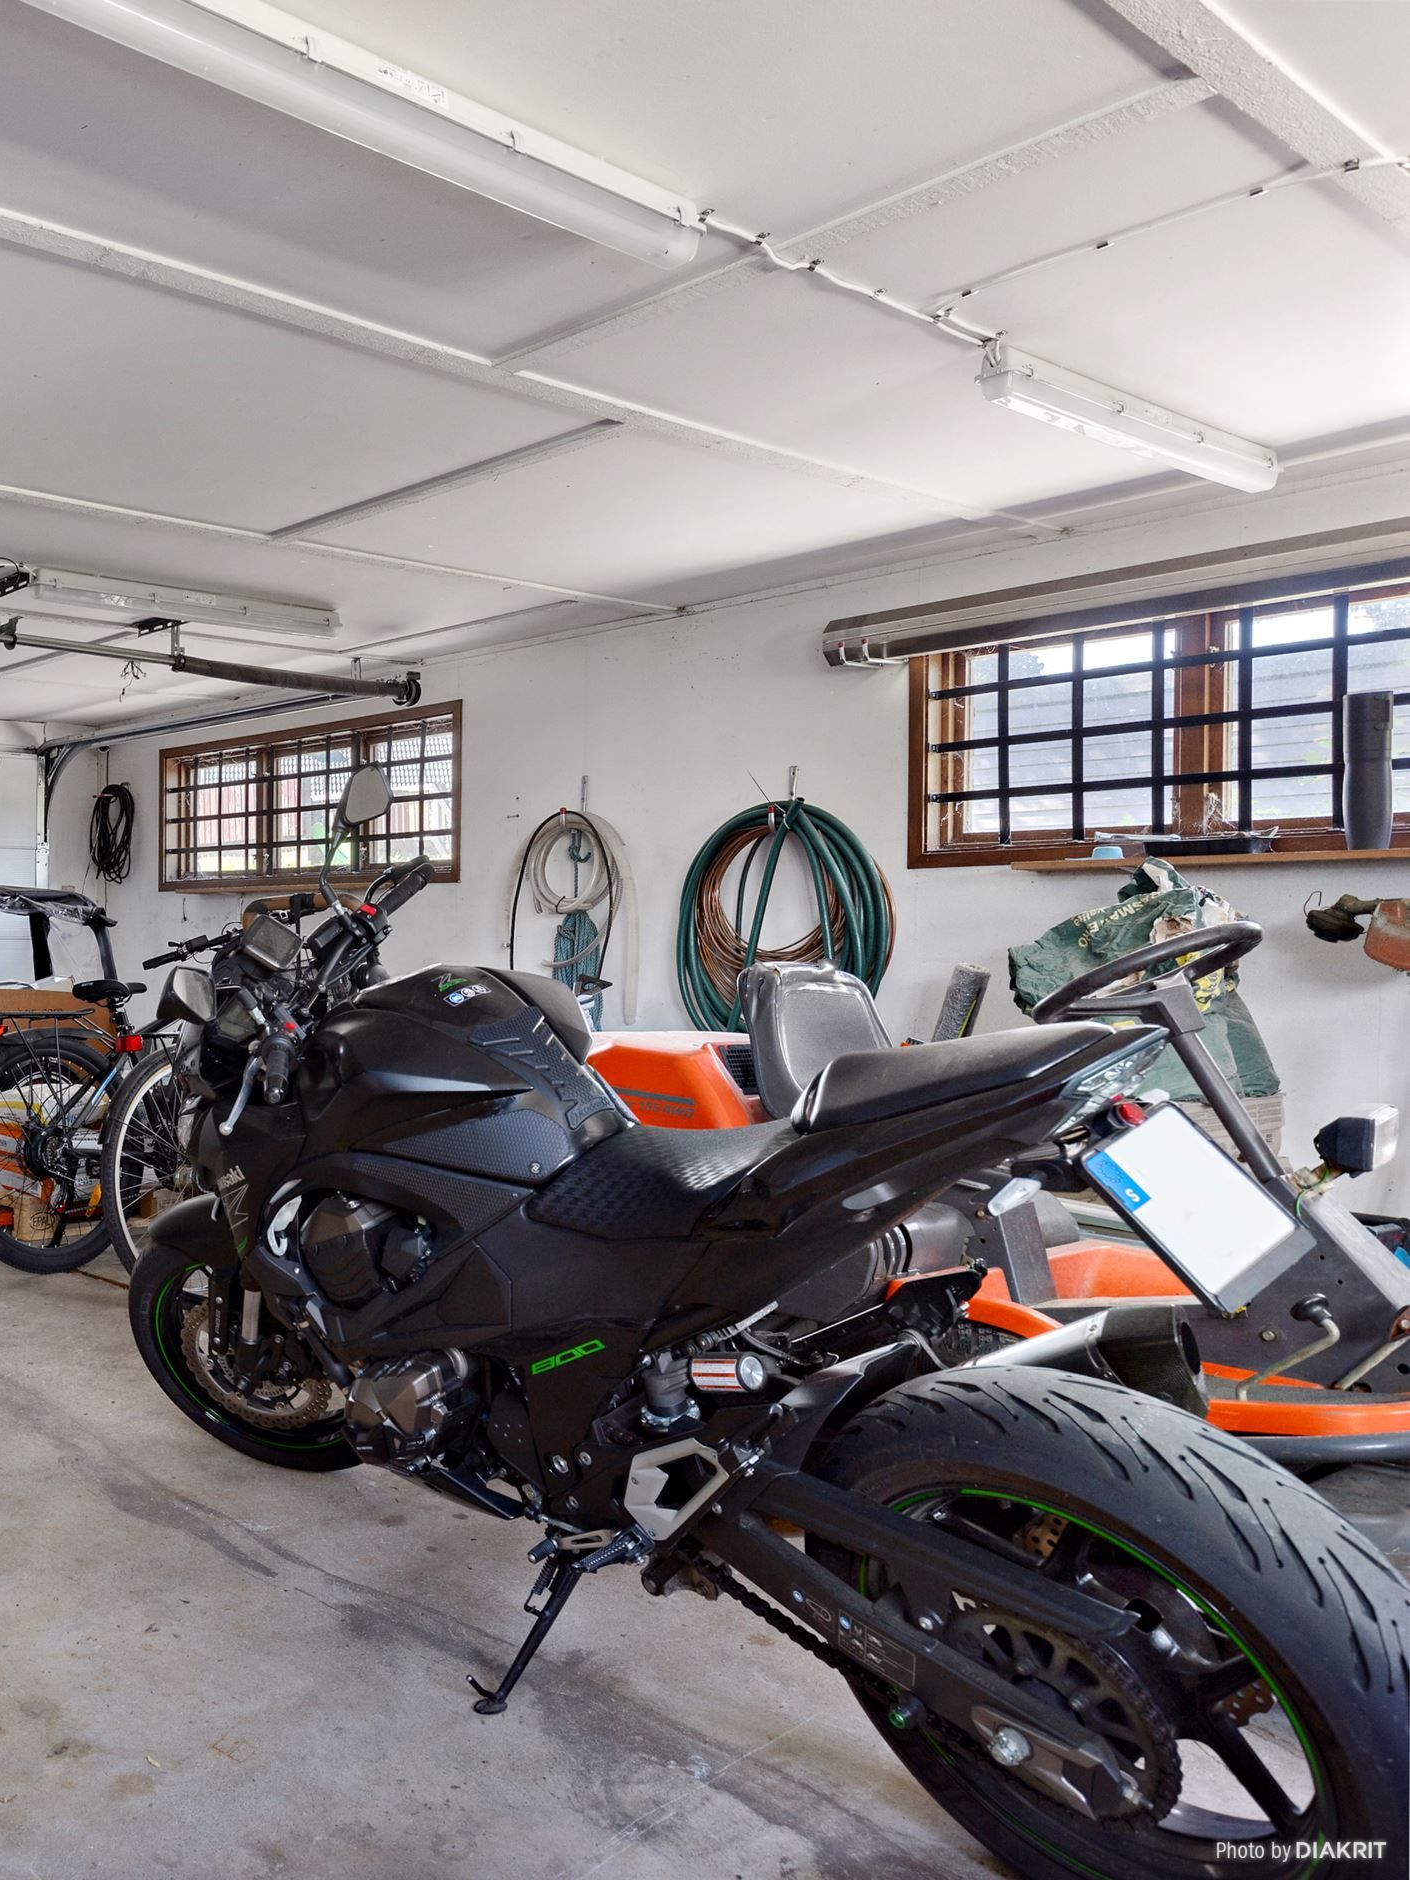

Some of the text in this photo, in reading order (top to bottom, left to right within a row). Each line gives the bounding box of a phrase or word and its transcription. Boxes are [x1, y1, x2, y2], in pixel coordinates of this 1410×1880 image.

[638, 1100, 659, 1113] 155
[661, 1103, 695, 1118] AWD
[1125, 1188, 1141, 1203] S
[531, 1339, 607, 1376] 800
